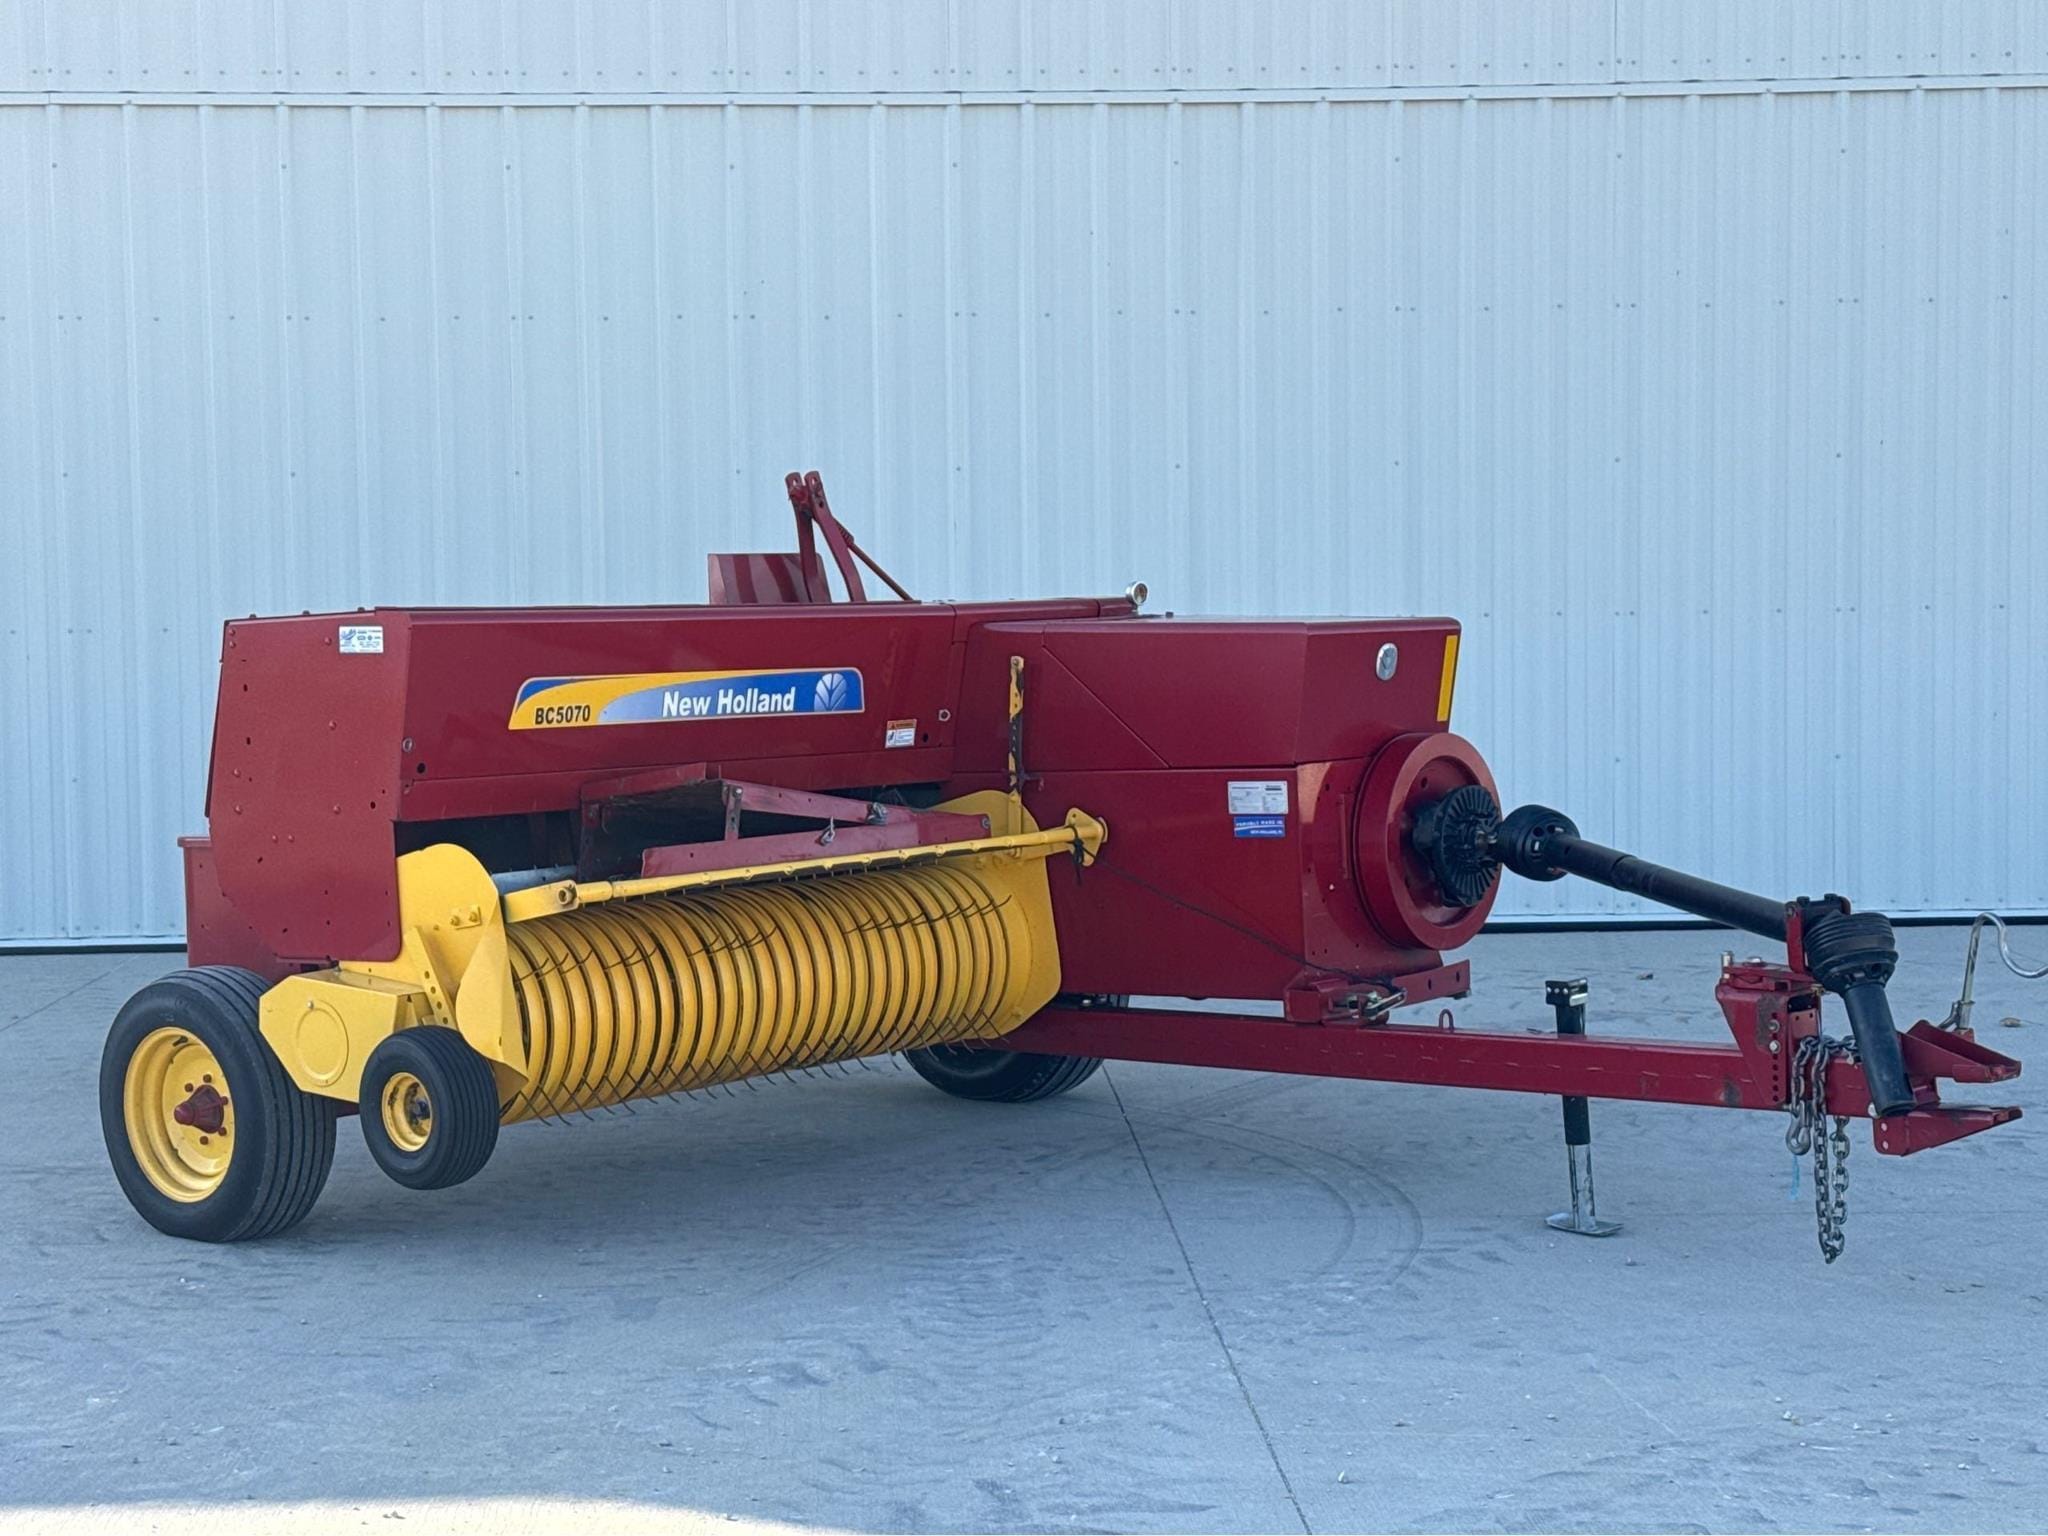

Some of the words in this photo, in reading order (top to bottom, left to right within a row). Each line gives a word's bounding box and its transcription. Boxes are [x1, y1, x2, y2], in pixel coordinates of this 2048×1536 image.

[535, 704, 591, 725] BC5070
[662, 690, 712, 718] New
[716, 686, 796, 714] Holland
